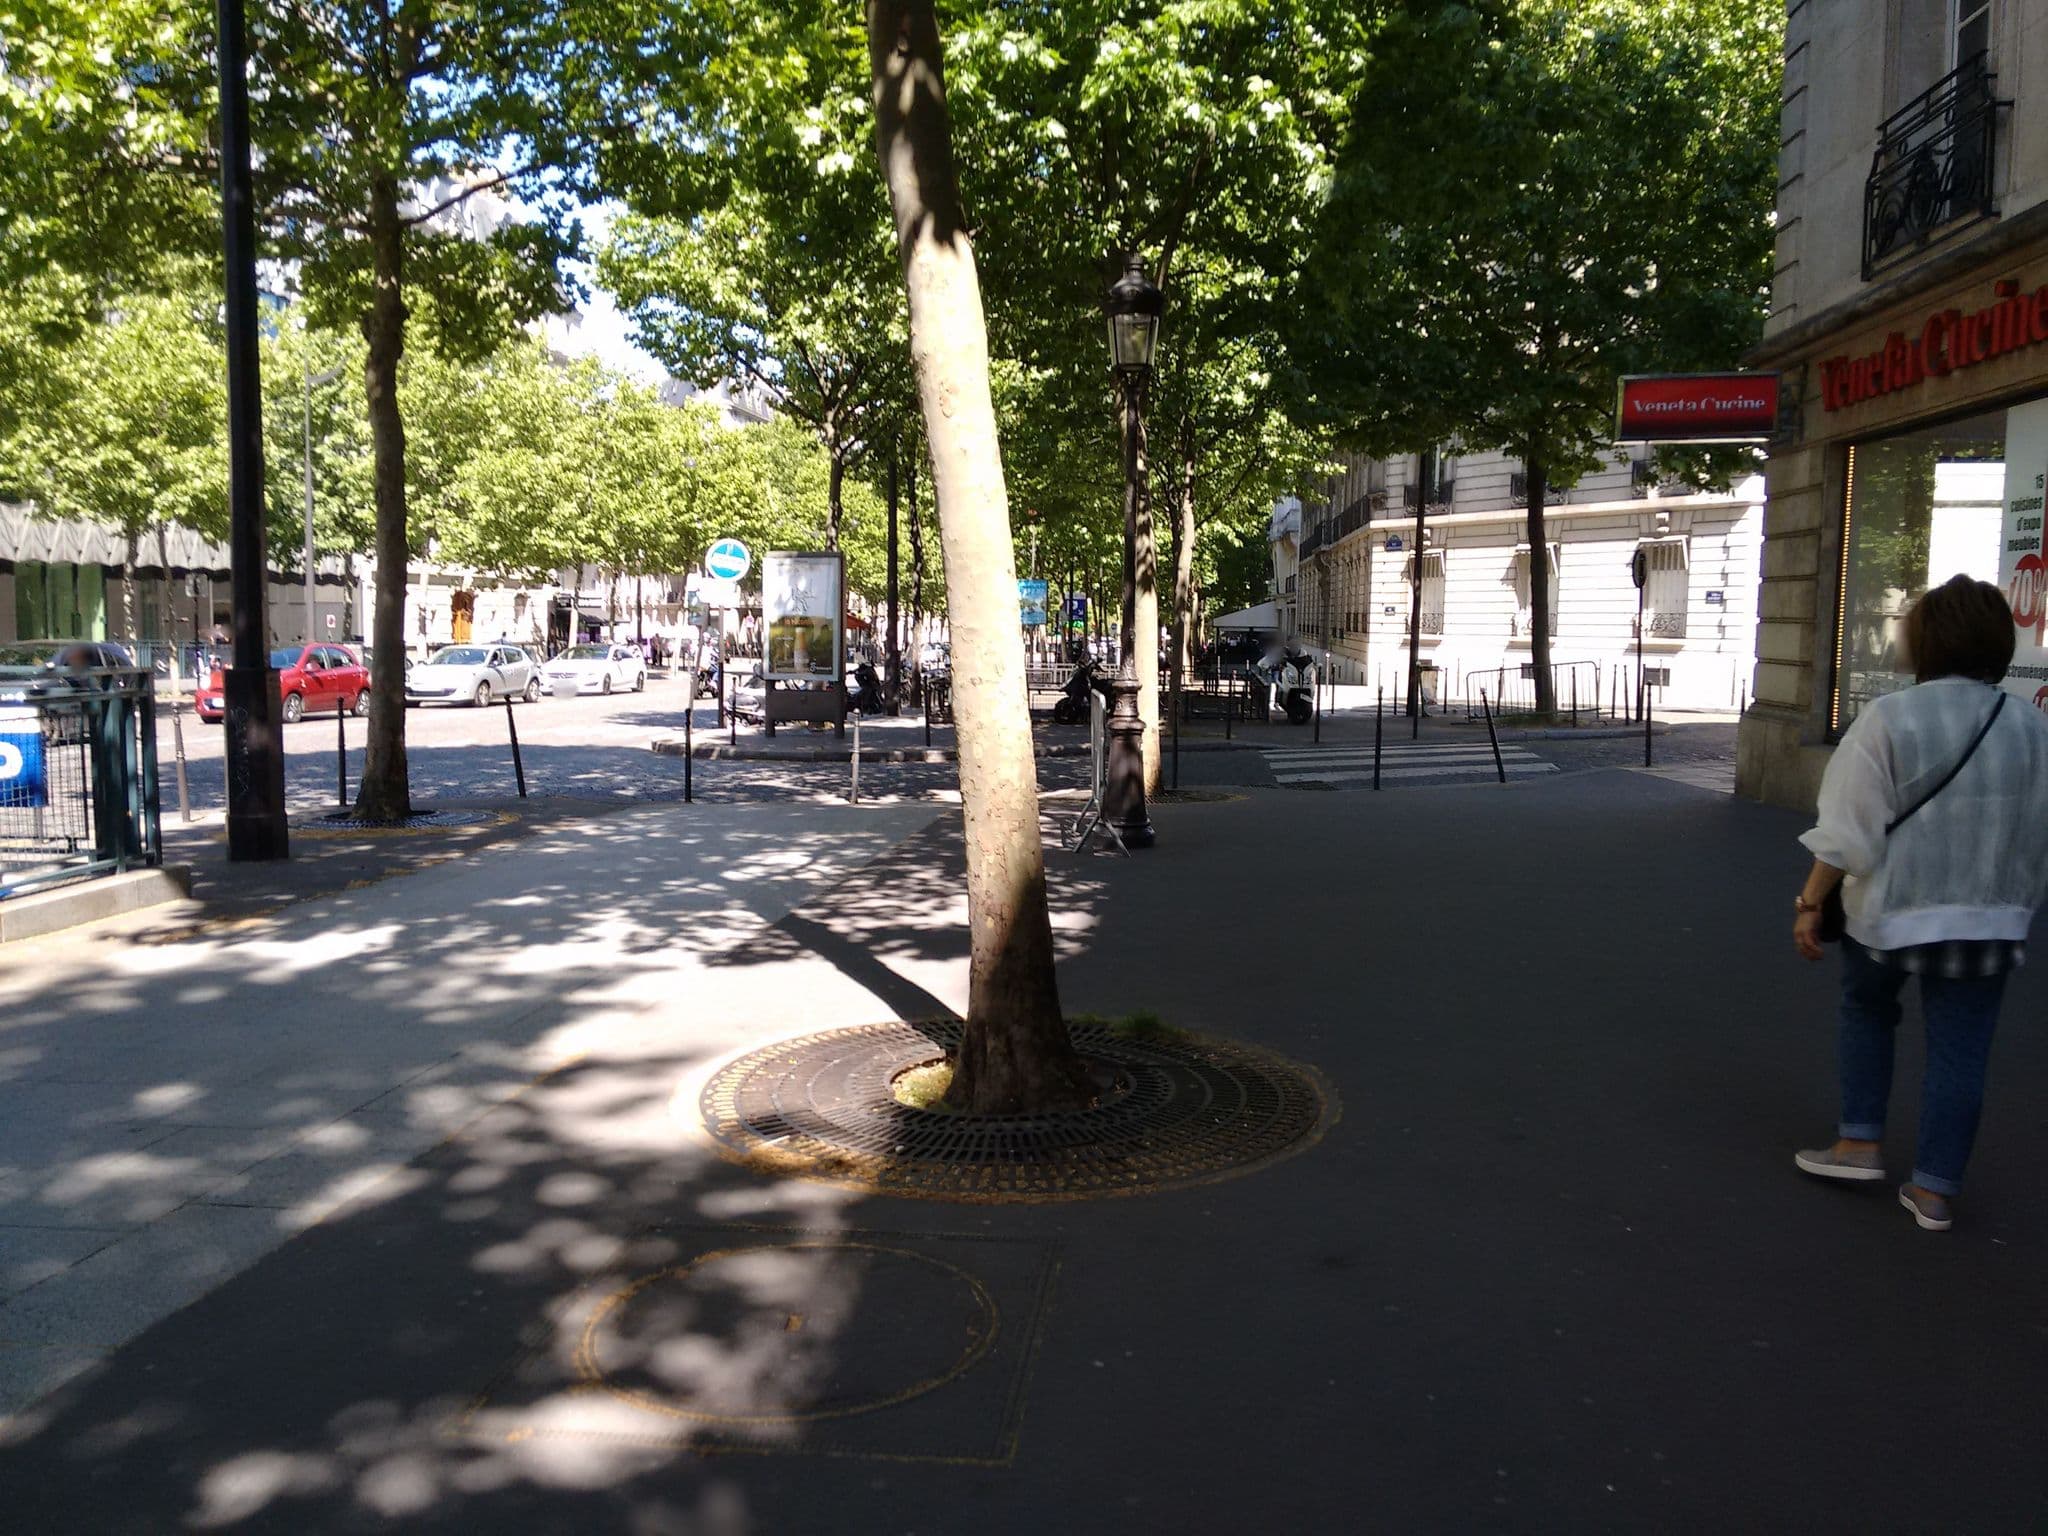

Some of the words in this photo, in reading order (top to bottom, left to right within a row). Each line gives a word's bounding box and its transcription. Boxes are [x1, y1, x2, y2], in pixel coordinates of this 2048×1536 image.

[1818, 331, 1923, 412] Veneta
[1633, 398, 1697, 412] Veneta
[1700, 395, 1765, 411] Cucine
[2010, 496, 2042, 512] cuisines
[2016, 517, 2041, 531] d'expo
[2007, 536, 2040, 552] meubles
